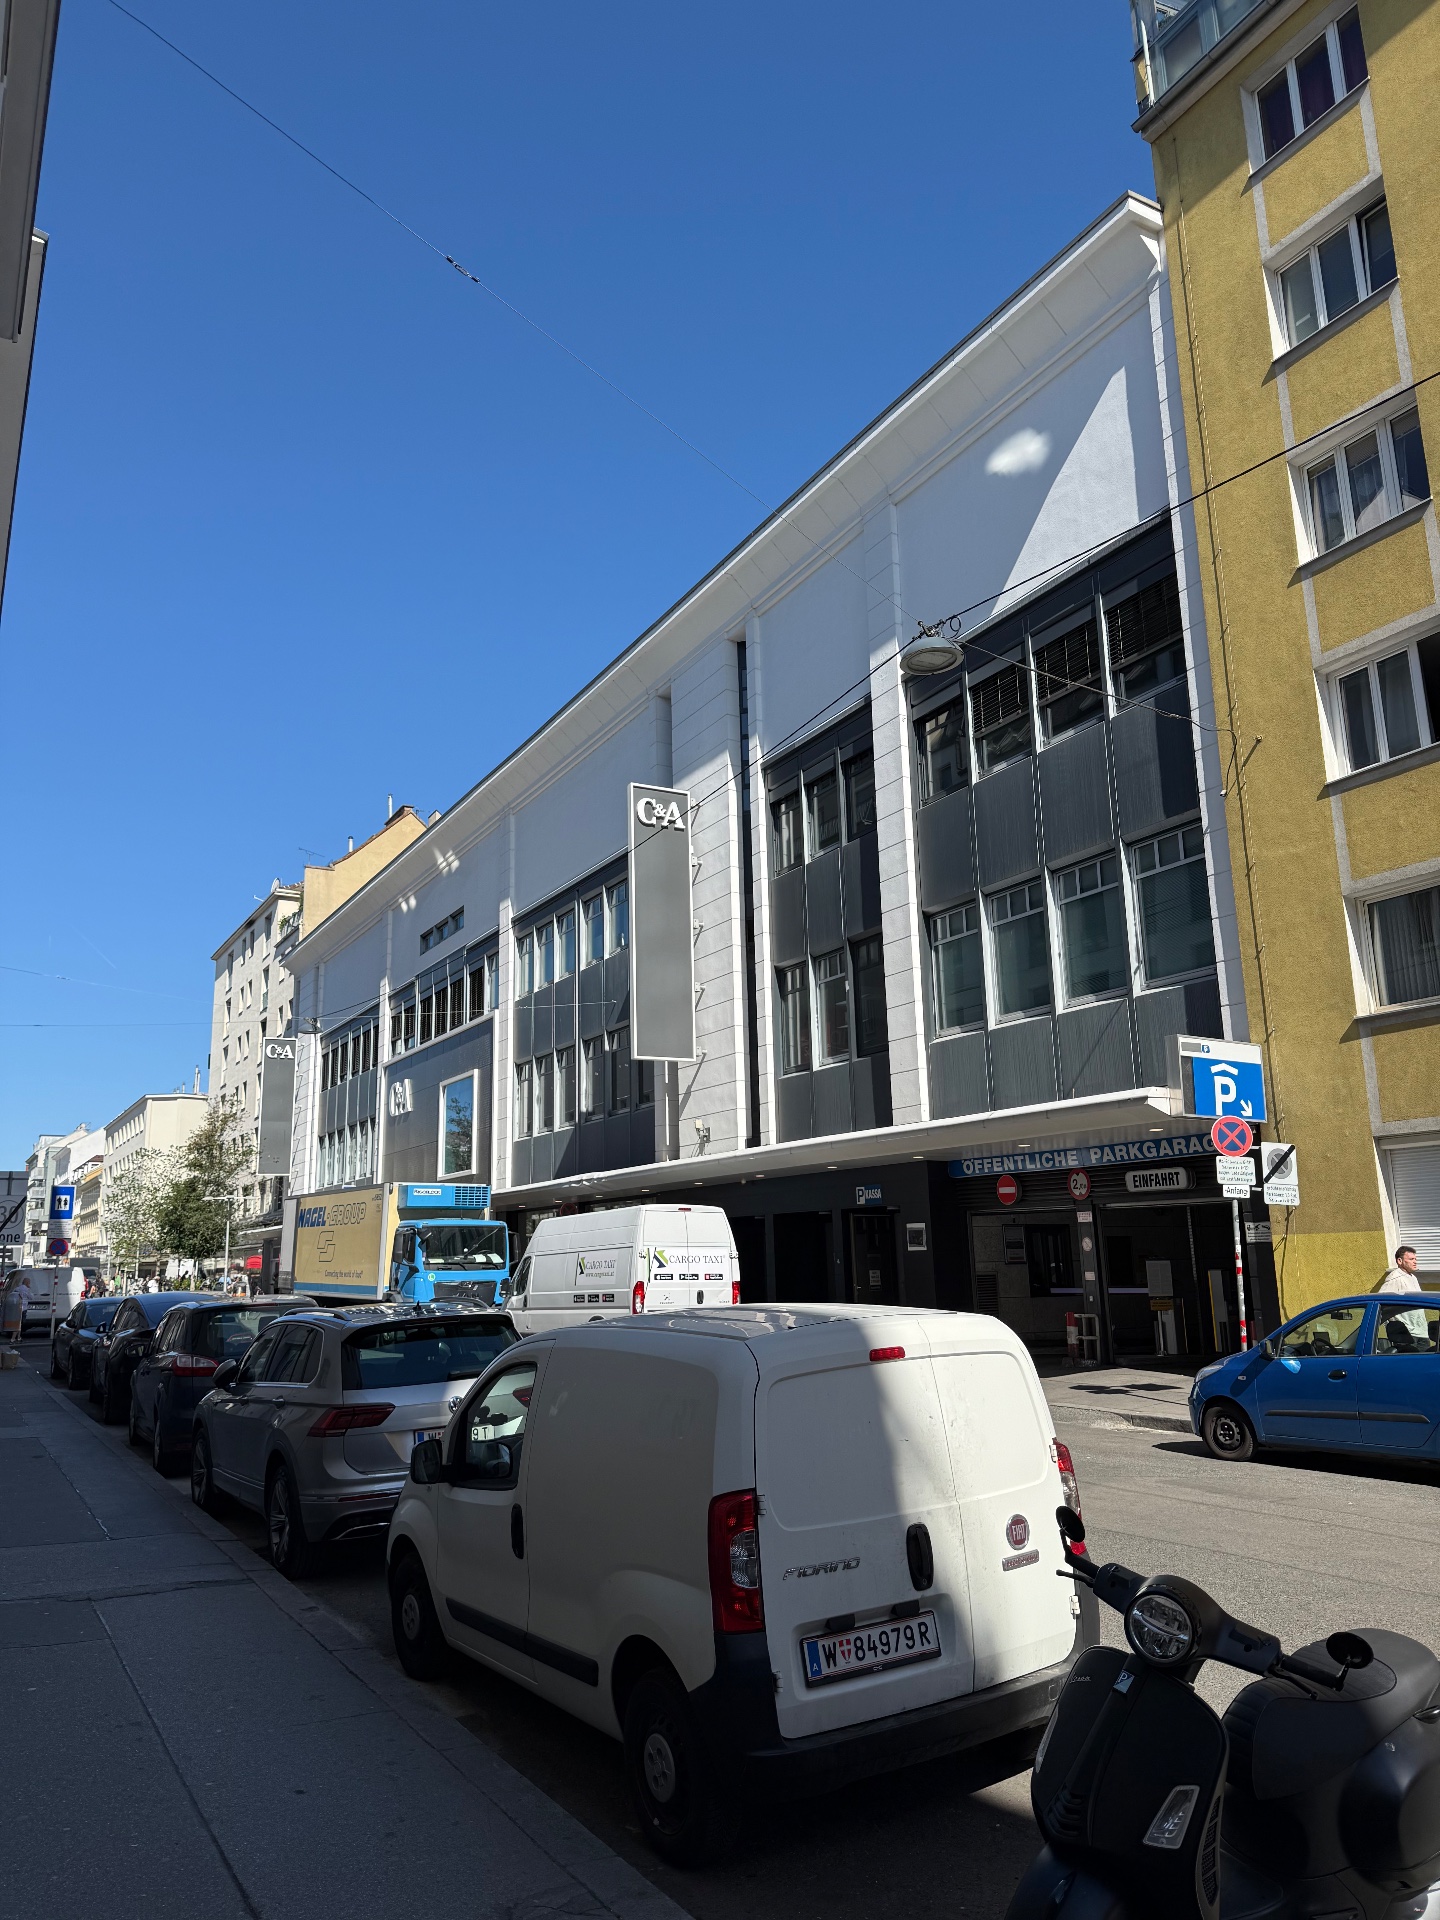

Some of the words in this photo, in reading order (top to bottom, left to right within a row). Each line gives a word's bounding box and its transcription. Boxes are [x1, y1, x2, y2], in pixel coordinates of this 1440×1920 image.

[636, 798, 686, 830] C&A
[266, 1044, 294, 1059] C&A
[388, 1078, 414, 1117] C&A
[1213, 1075, 1237, 1116] P
[962, 1150, 1079, 1175] ÖFFENTLICHE
[1089, 1134, 1215, 1164] PARKGARAG
[1132, 1171, 1181, 1189] EINFAHRT
[0, 1233, 20, 1243] one
[668, 1254, 701, 1264] CARGO
[702, 1254, 723, 1264] TAXI
[1011, 1523, 1026, 1541] FIAT
[782, 1557, 861, 1581] FIORINO
[812, 1663, 819, 1672] A
[821, 1641, 838, 1669] W
[853, 1621, 932, 1662] 84979R
